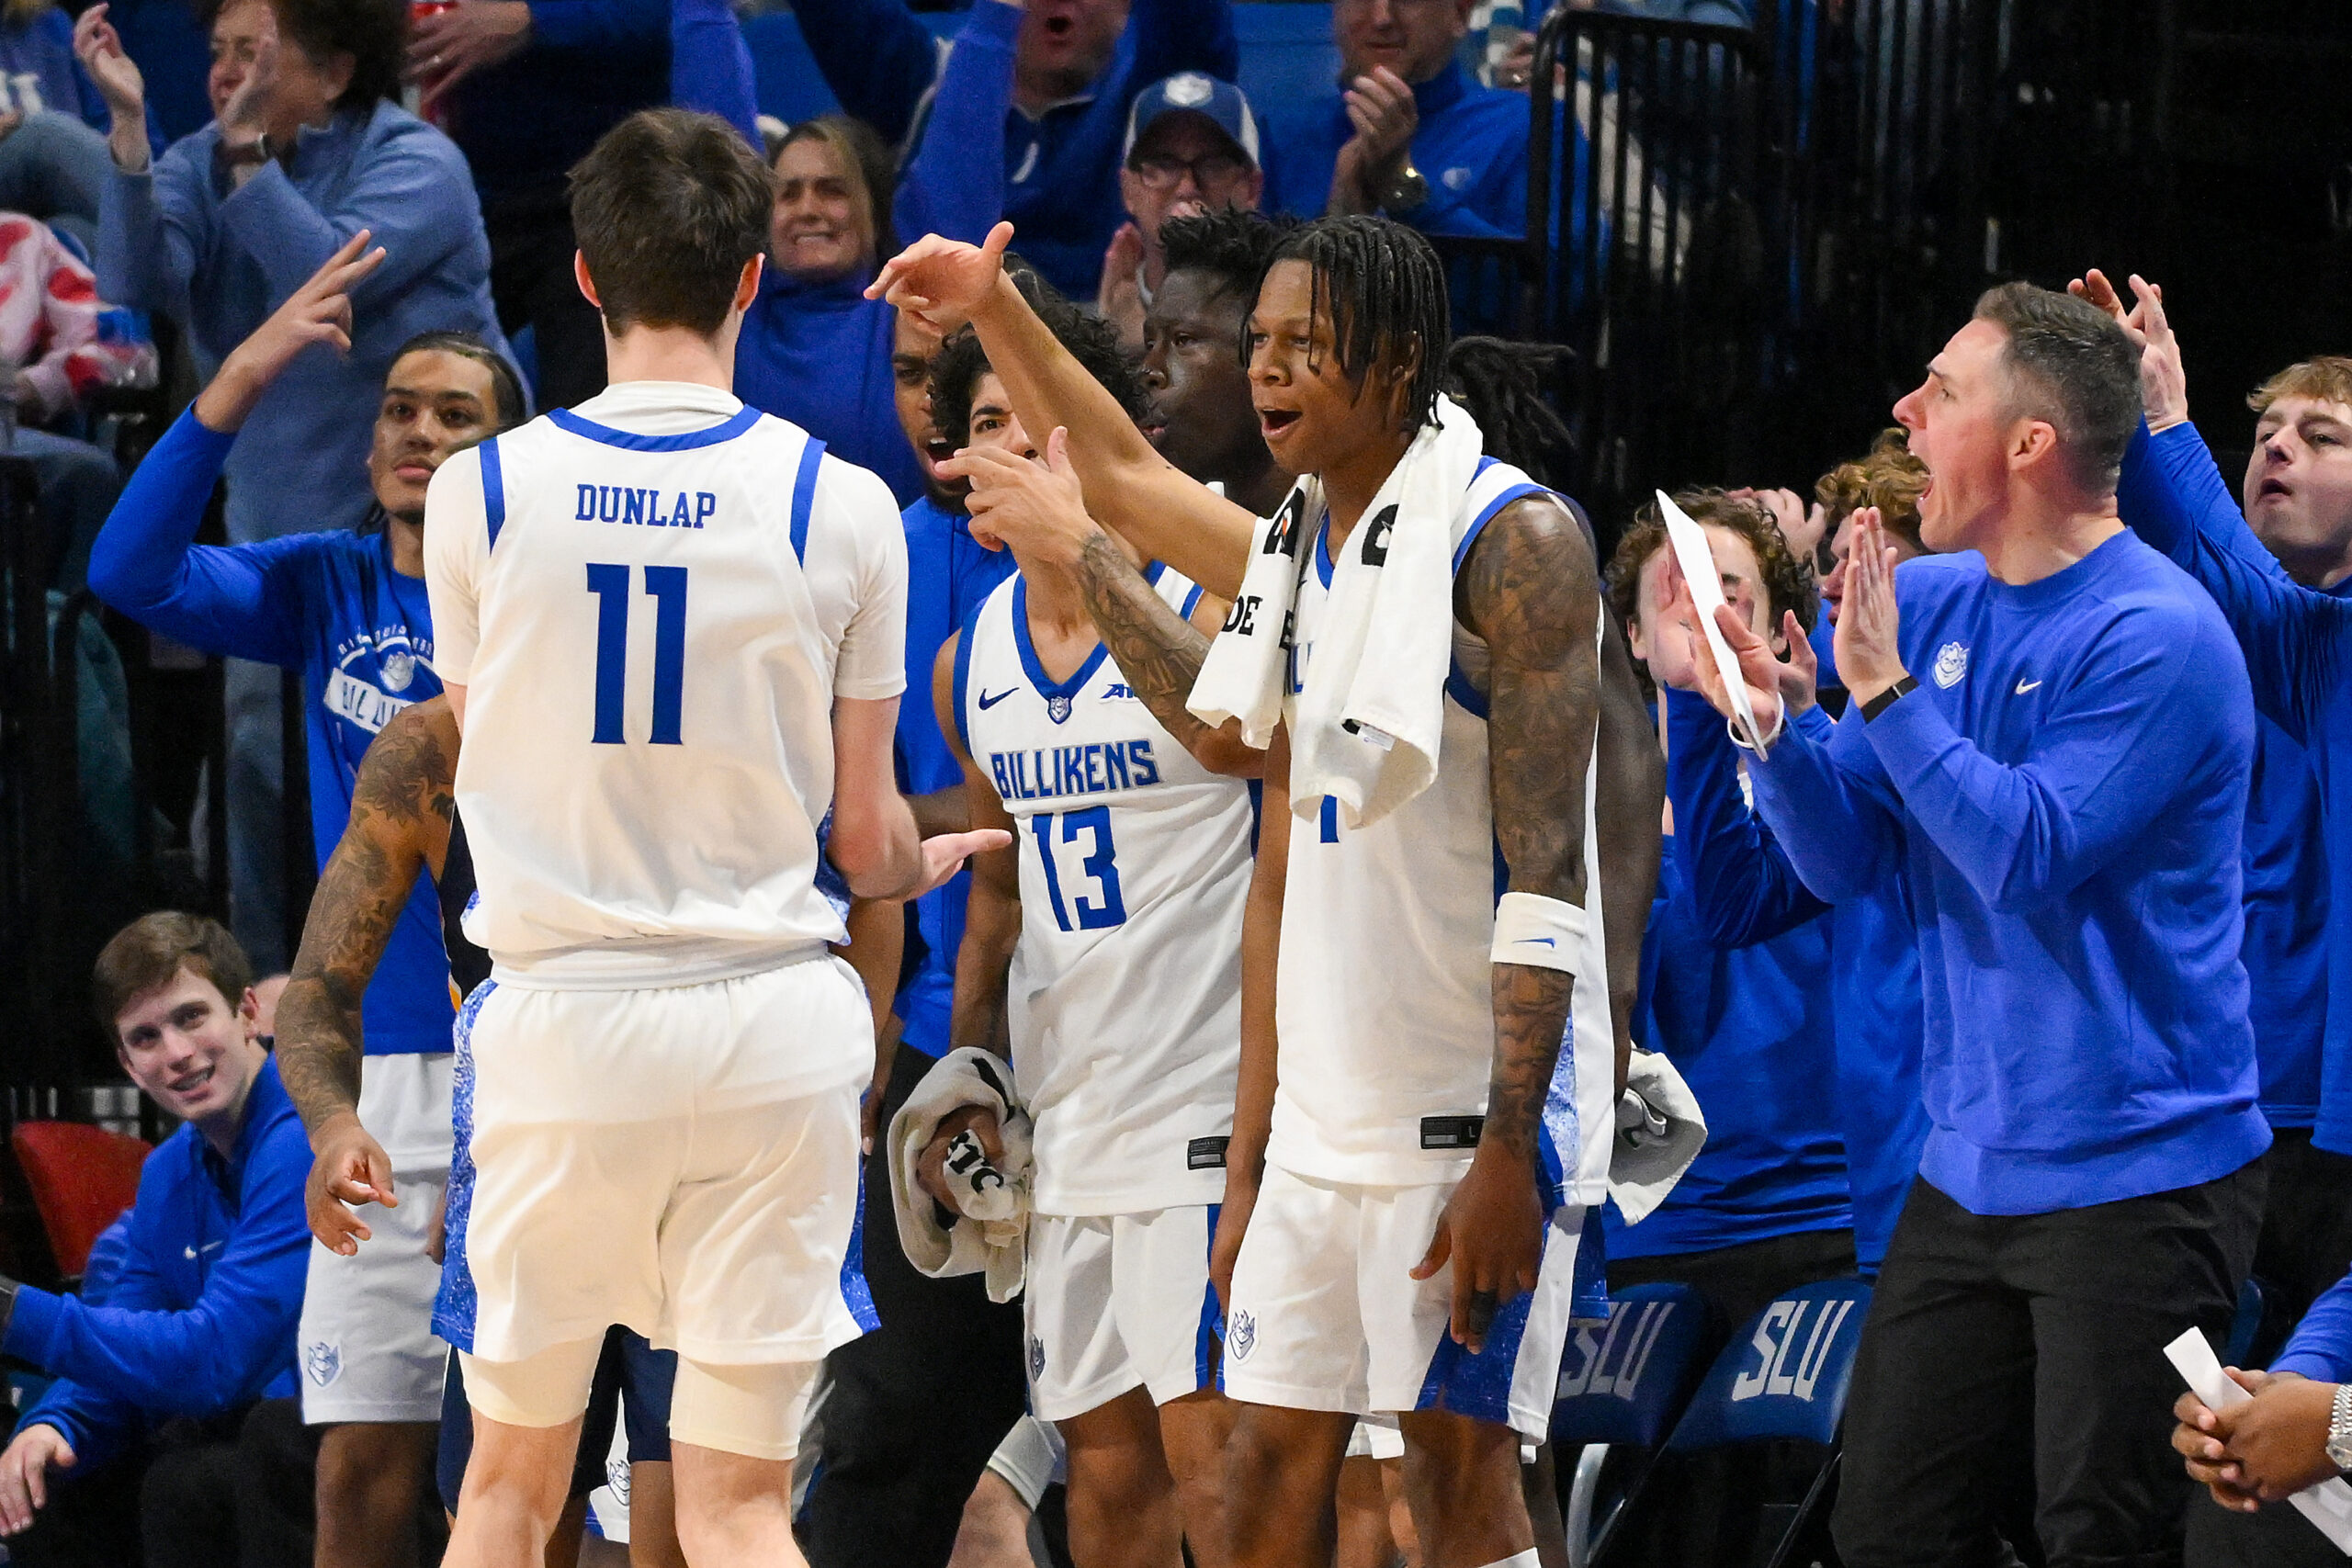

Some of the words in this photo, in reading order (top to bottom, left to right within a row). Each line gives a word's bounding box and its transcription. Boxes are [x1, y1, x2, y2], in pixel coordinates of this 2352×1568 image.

[575, 483, 716, 529] DUNLAP
[585, 562, 688, 745] 11
[989, 738, 1163, 801] BILLIKENS
[1031, 805, 1127, 931] 13
[1732, 1300, 1855, 1403] SLU
